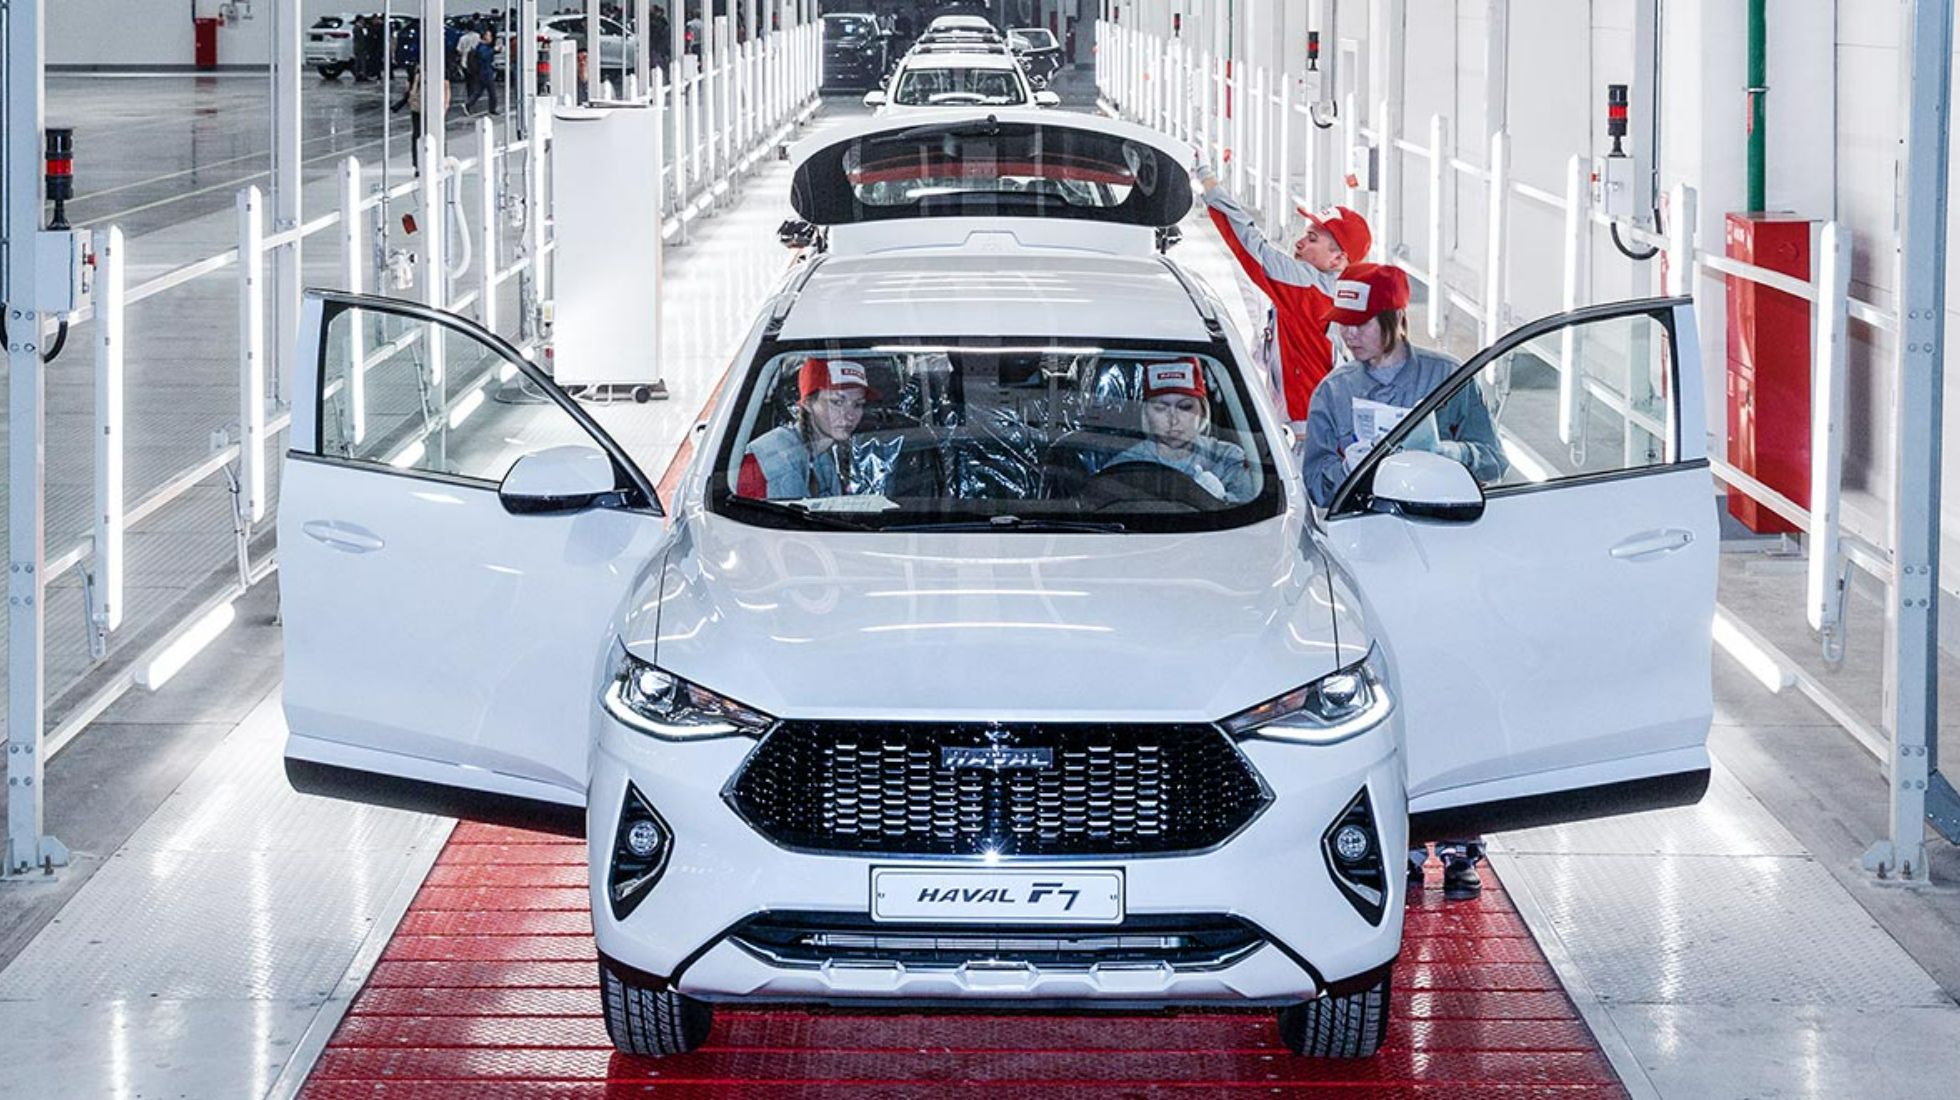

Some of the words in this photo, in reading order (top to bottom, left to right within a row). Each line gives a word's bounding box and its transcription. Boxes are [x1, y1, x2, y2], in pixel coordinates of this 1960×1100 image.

[945, 751, 1049, 766] HAVAL
[917, 888, 1015, 903] HAVAL
[1027, 882, 1080, 911] F7
